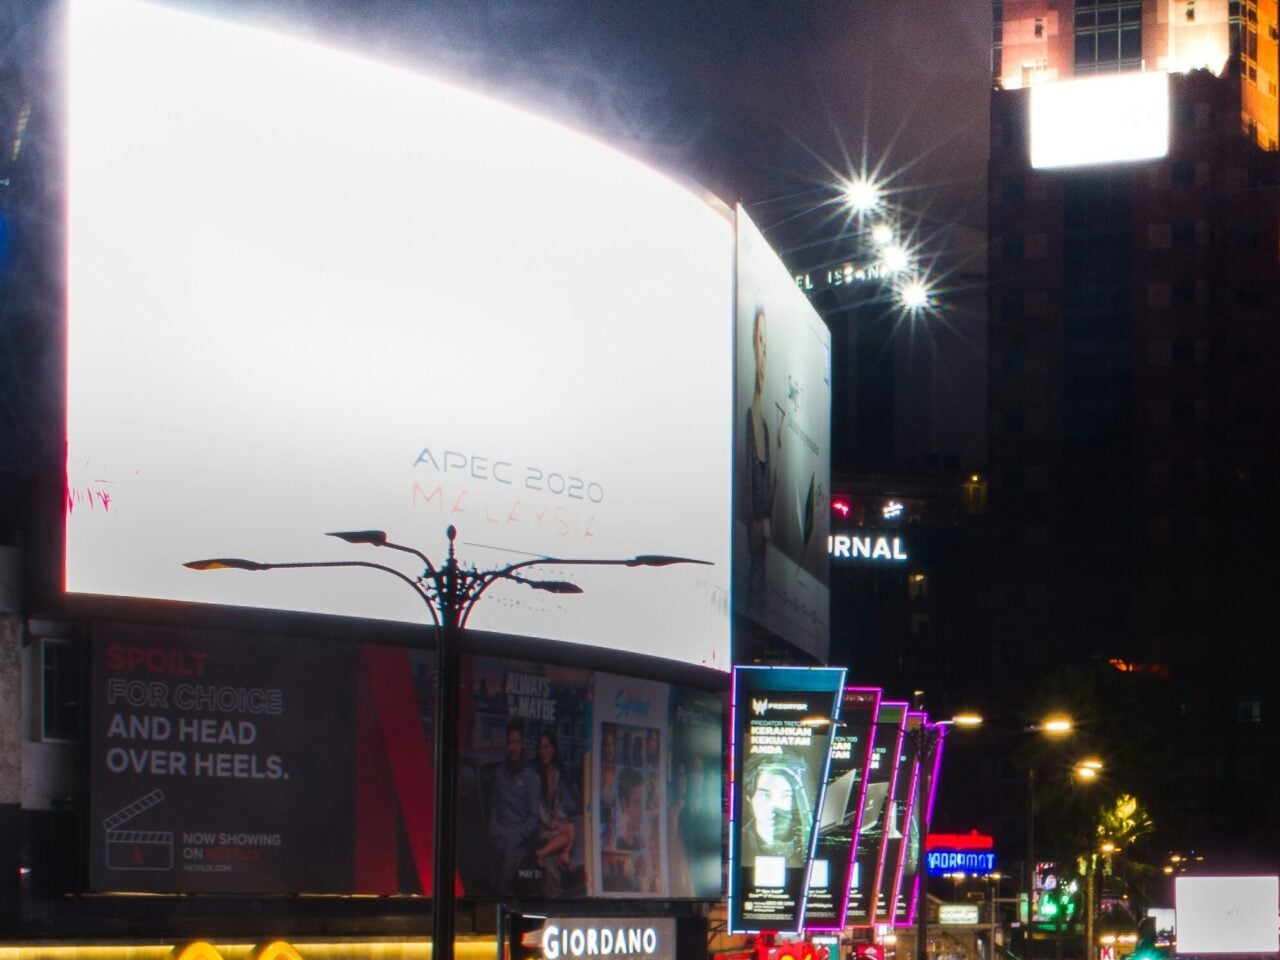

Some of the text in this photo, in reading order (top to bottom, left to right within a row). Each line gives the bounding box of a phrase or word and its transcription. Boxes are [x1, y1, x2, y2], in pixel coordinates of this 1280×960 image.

[413, 447, 603, 504] APEC 2020
[412, 480, 600, 539] MALAYSIA
[106, 645, 209, 676] SPOILT
[107, 678, 283, 716] FOR CHOICE
[518, 696, 557, 721] MAYBE
[107, 713, 257, 745] AND HEAD
[106, 747, 290, 780] OVER HEELS.
[182, 833, 282, 847] NOW SHOWING
[182, 847, 205, 860] ON
[542, 925, 657, 960] GIORDANO
